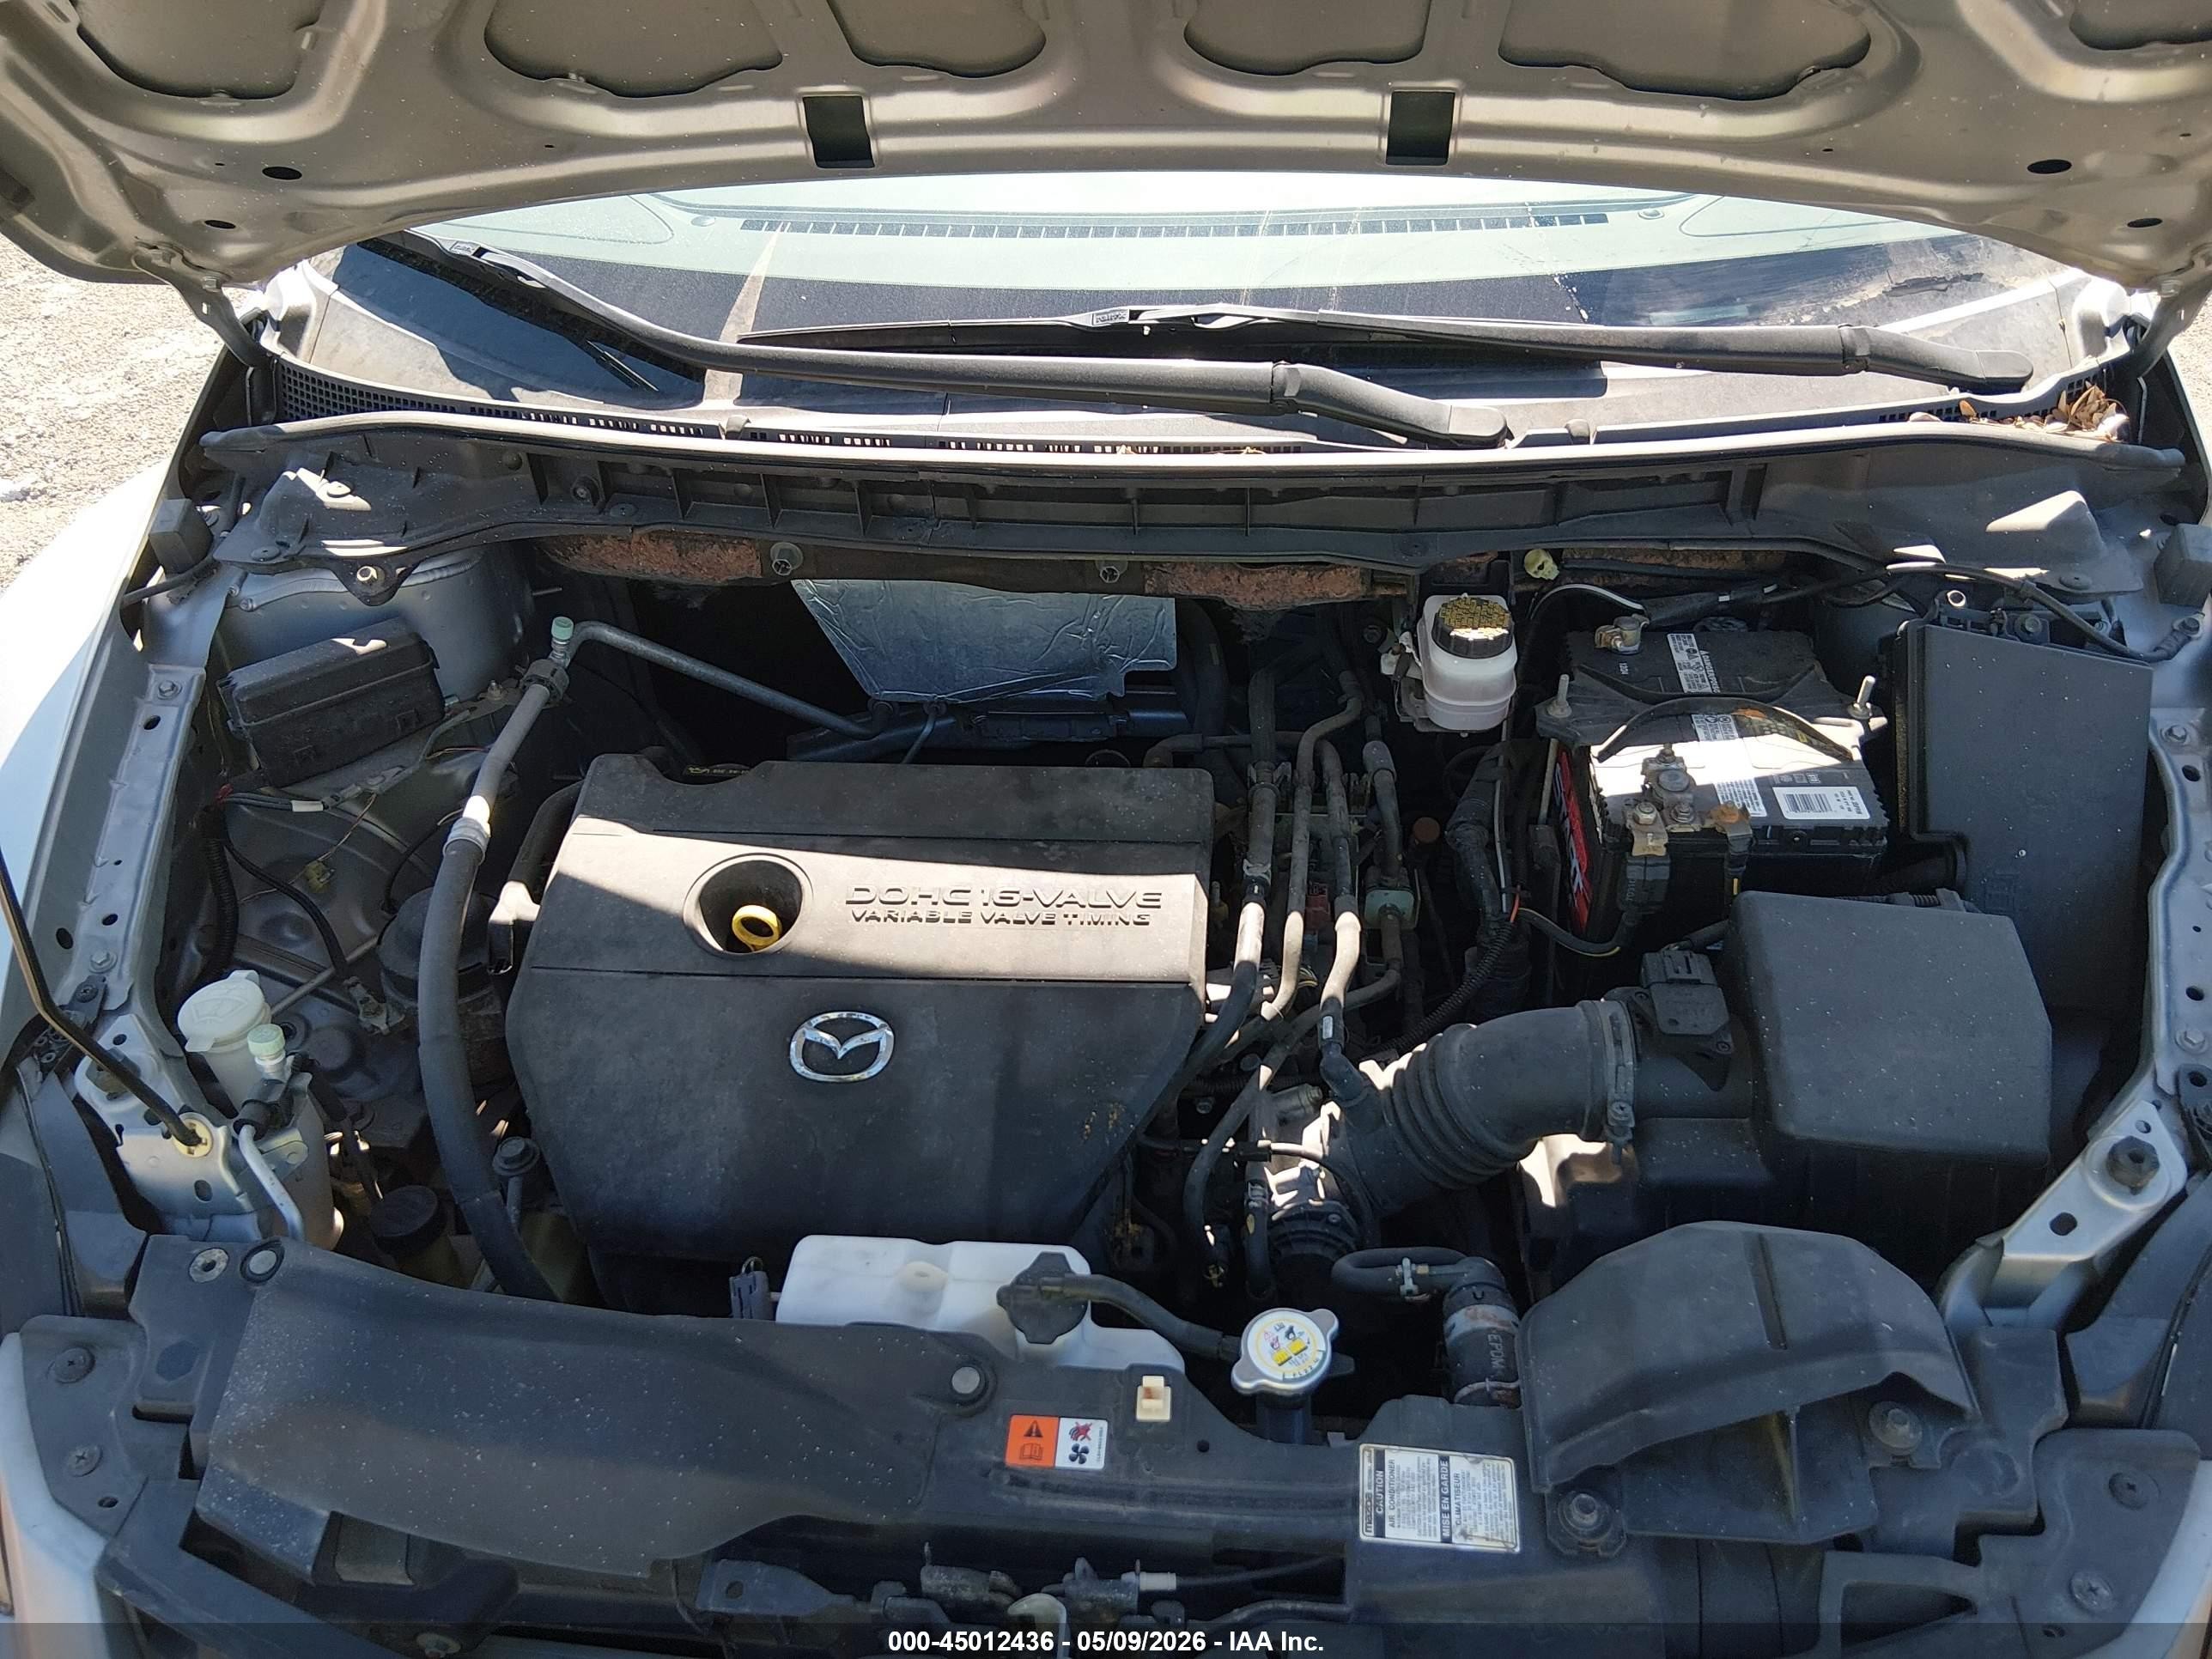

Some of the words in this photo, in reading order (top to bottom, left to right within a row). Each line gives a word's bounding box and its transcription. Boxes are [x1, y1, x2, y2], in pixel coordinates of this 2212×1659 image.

[845, 885, 971, 906] DOHC
[981, 886, 1163, 908] 16-VALVE
[851, 908, 972, 923] VARIABLE
[980, 910, 1056, 926] VALVE
[1063, 912, 1151, 927] TIMING
[1486, 1333, 1505, 1369] EPDM
[1439, 1460, 1450, 1495] GARDE
[1376, 1470, 1385, 1515] CAUTION
[1441, 1497, 1450, 1510] EN
[1441, 1512, 1451, 1537] MISE
